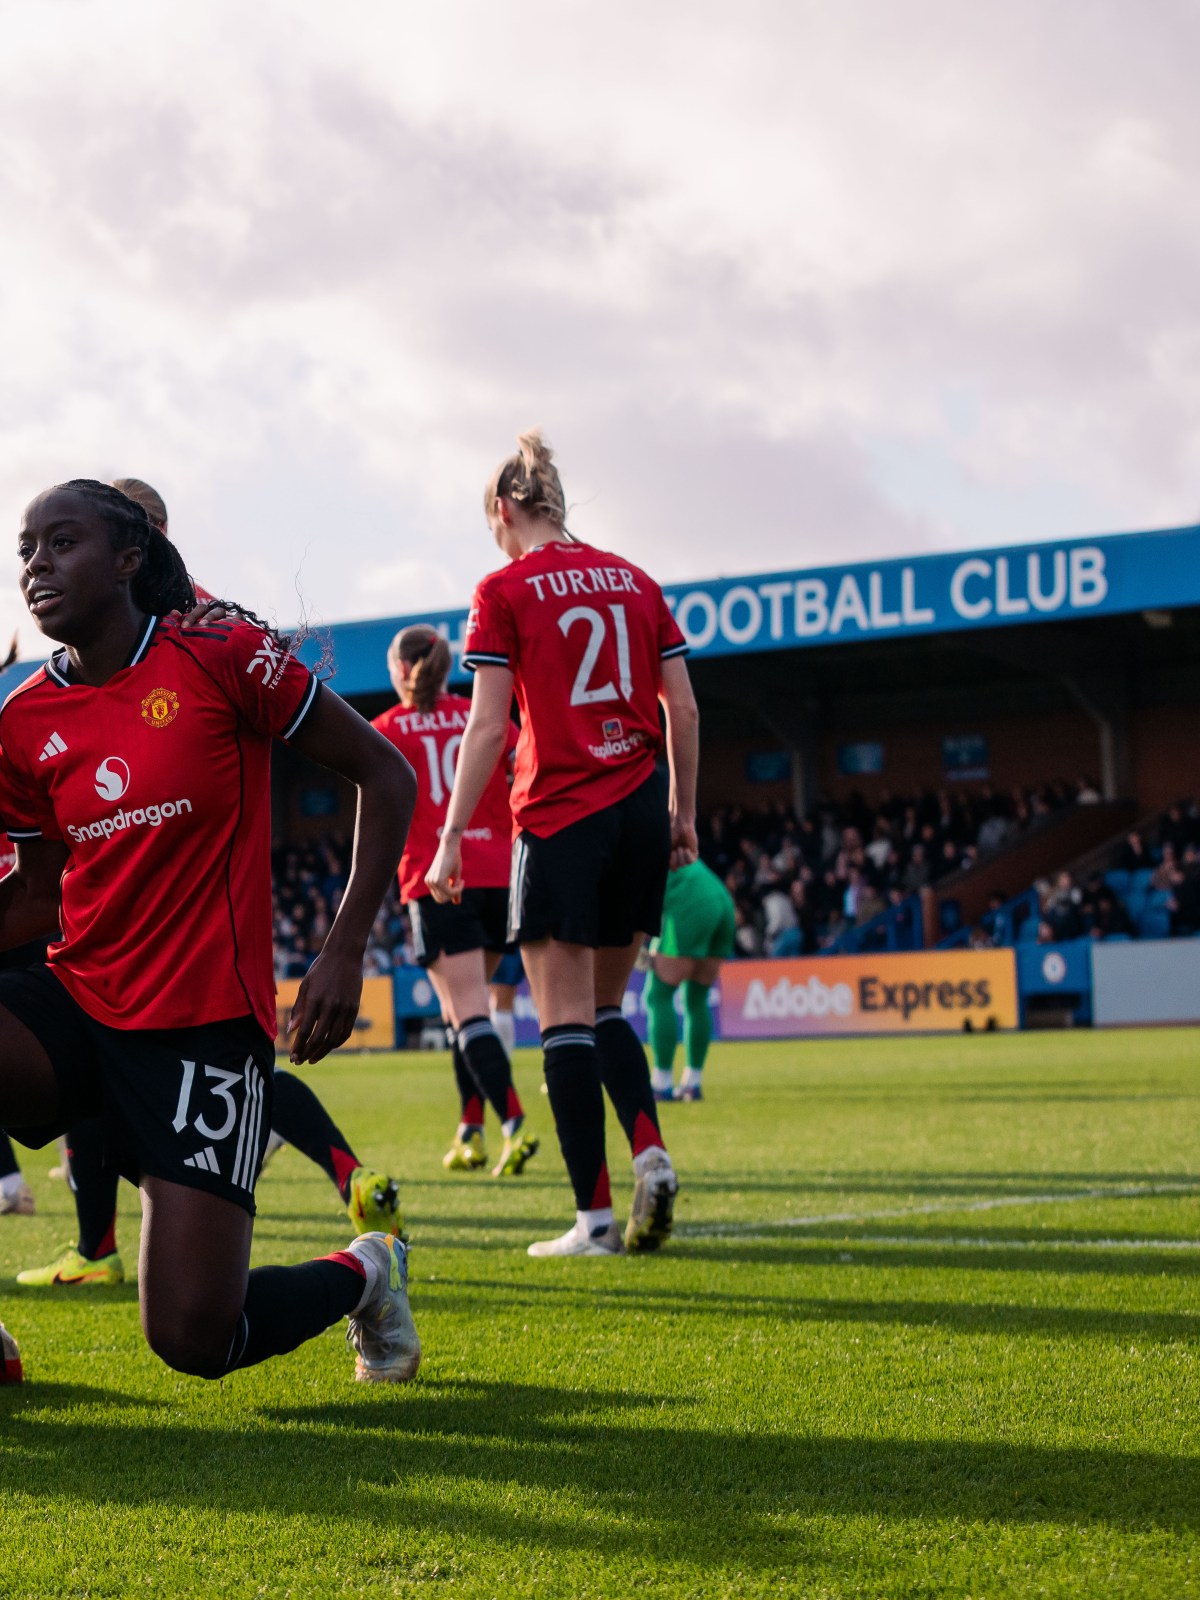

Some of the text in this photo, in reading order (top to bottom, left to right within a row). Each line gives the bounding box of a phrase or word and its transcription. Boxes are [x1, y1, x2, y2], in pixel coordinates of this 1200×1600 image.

[526, 567, 642, 601] TURNER
[950, 546, 1109, 620] CLUB
[557, 604, 634, 706] 21
[66, 798, 193, 844] Snapdragon
[742, 974, 992, 1024] Adobe Express
[172, 1059, 244, 1140] 13
